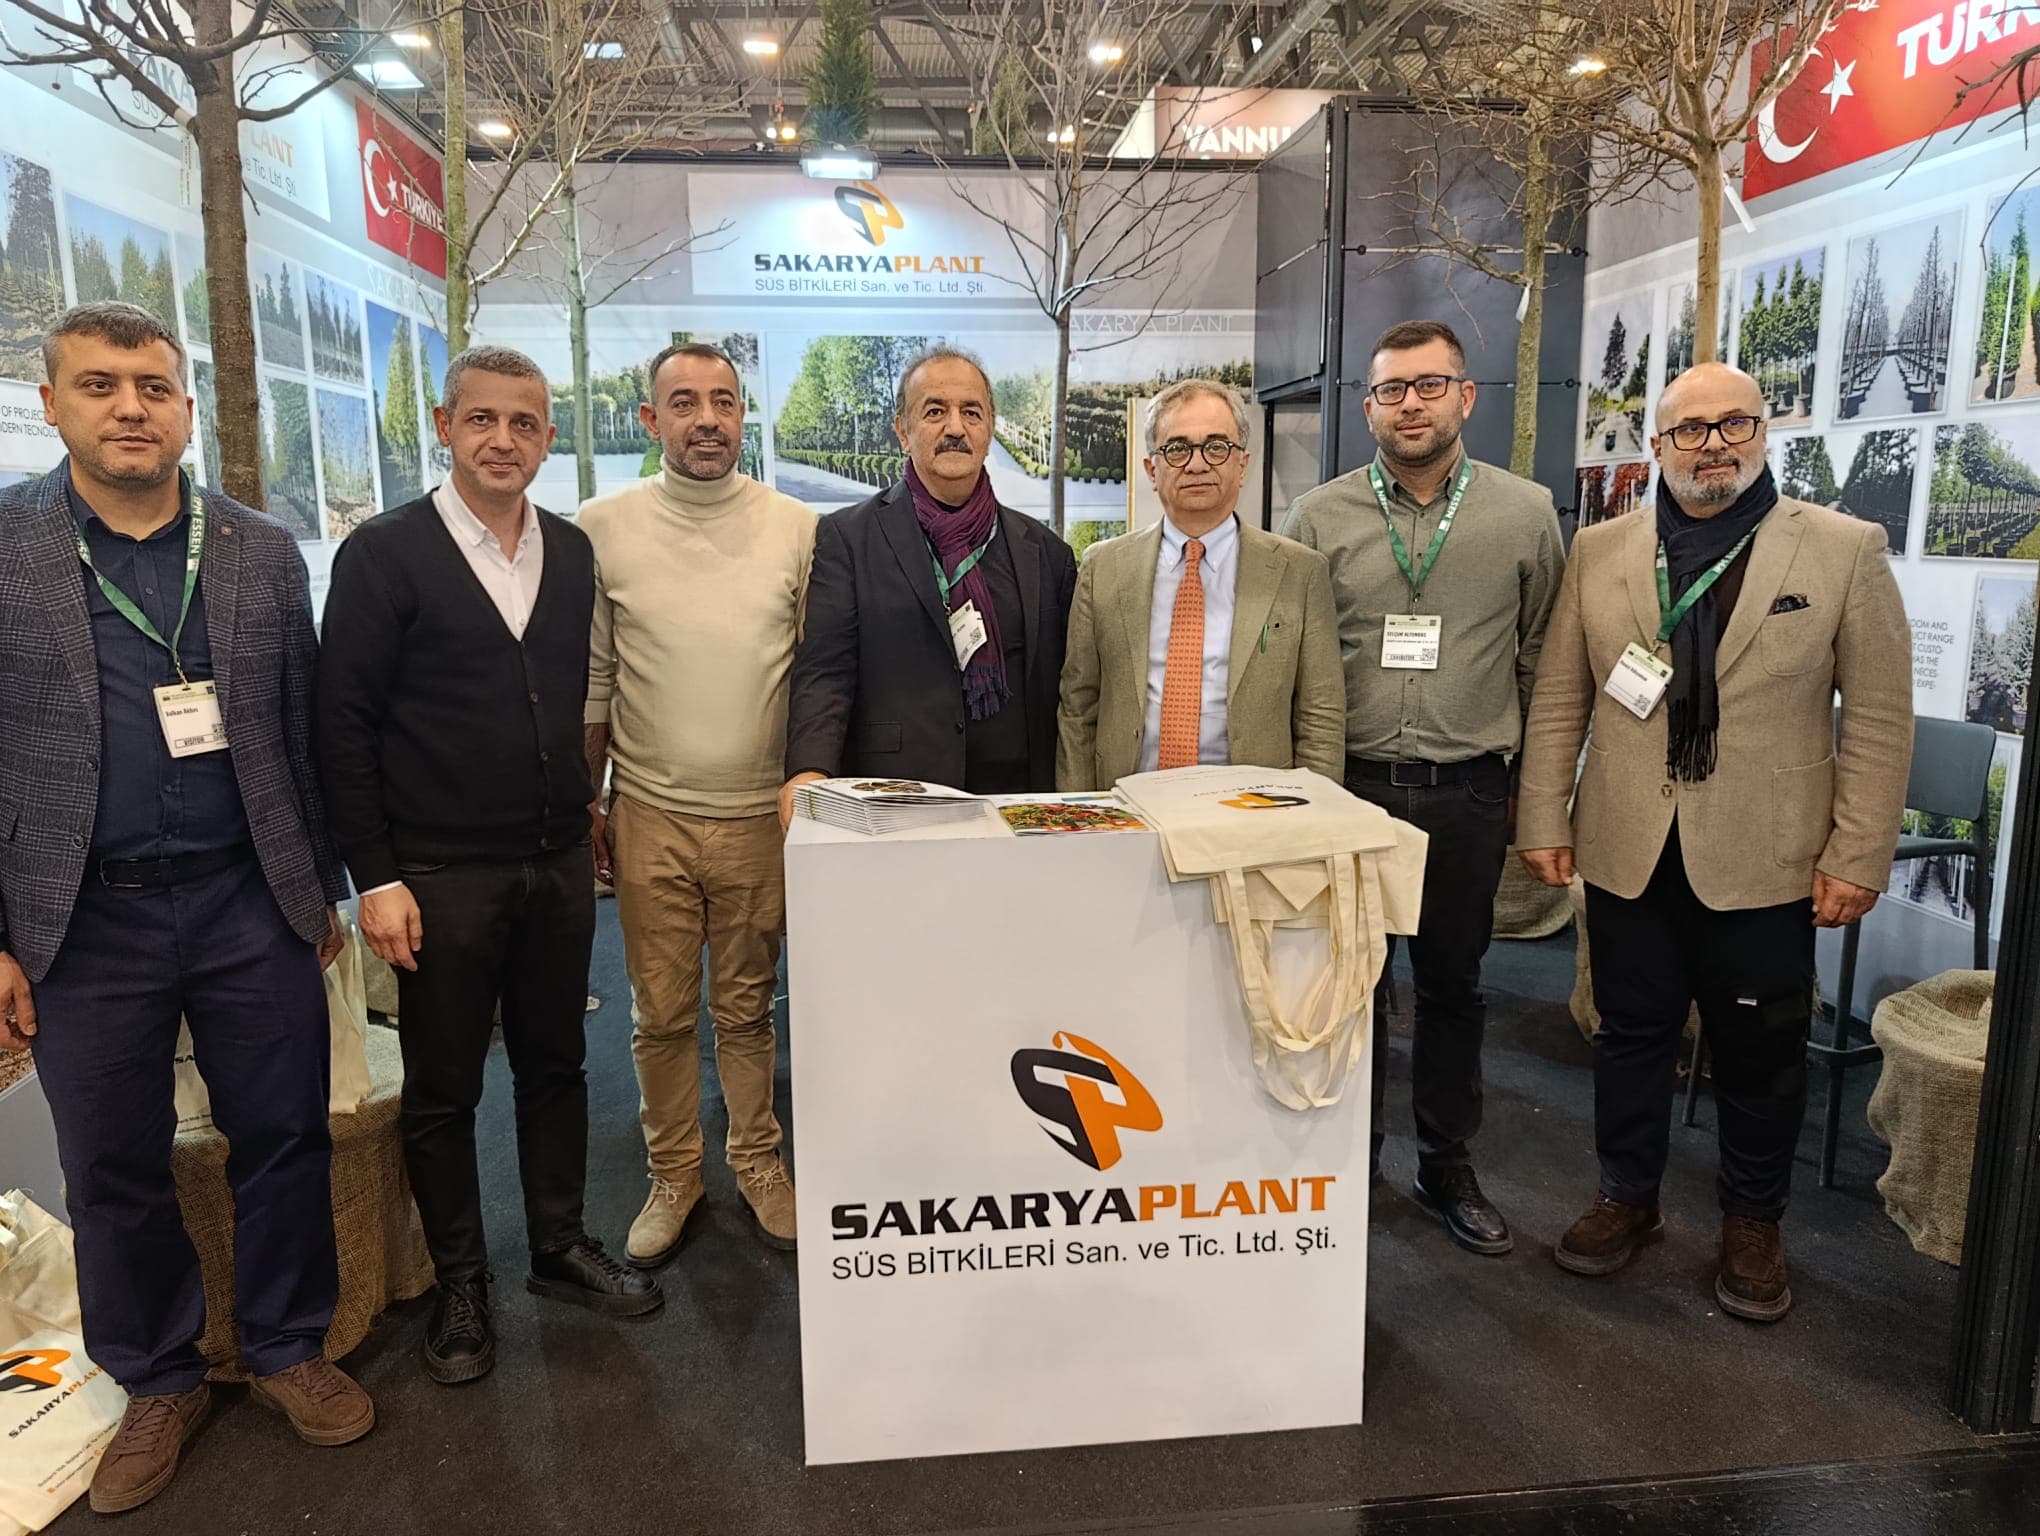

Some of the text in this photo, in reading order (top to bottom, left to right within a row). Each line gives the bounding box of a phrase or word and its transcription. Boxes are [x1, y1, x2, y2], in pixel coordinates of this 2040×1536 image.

[754, 254, 986, 273] SAKARYAPLANT
[755, 277, 987, 296] SÜS BİTKİLERİ San. ve Tic. Ltd. Şti.
[190, 495, 205, 554] IPM ESSEN
[1931, 621, 1948, 631] AND
[1927, 632, 1955, 645] RANGE
[1925, 656, 1939, 666] THE
[831, 1176, 1337, 1241] SAKARYAPLANT
[832, 1226, 1337, 1280] SÜS BİTKİLERİ San. ve Tic. Ltd. Şti.
